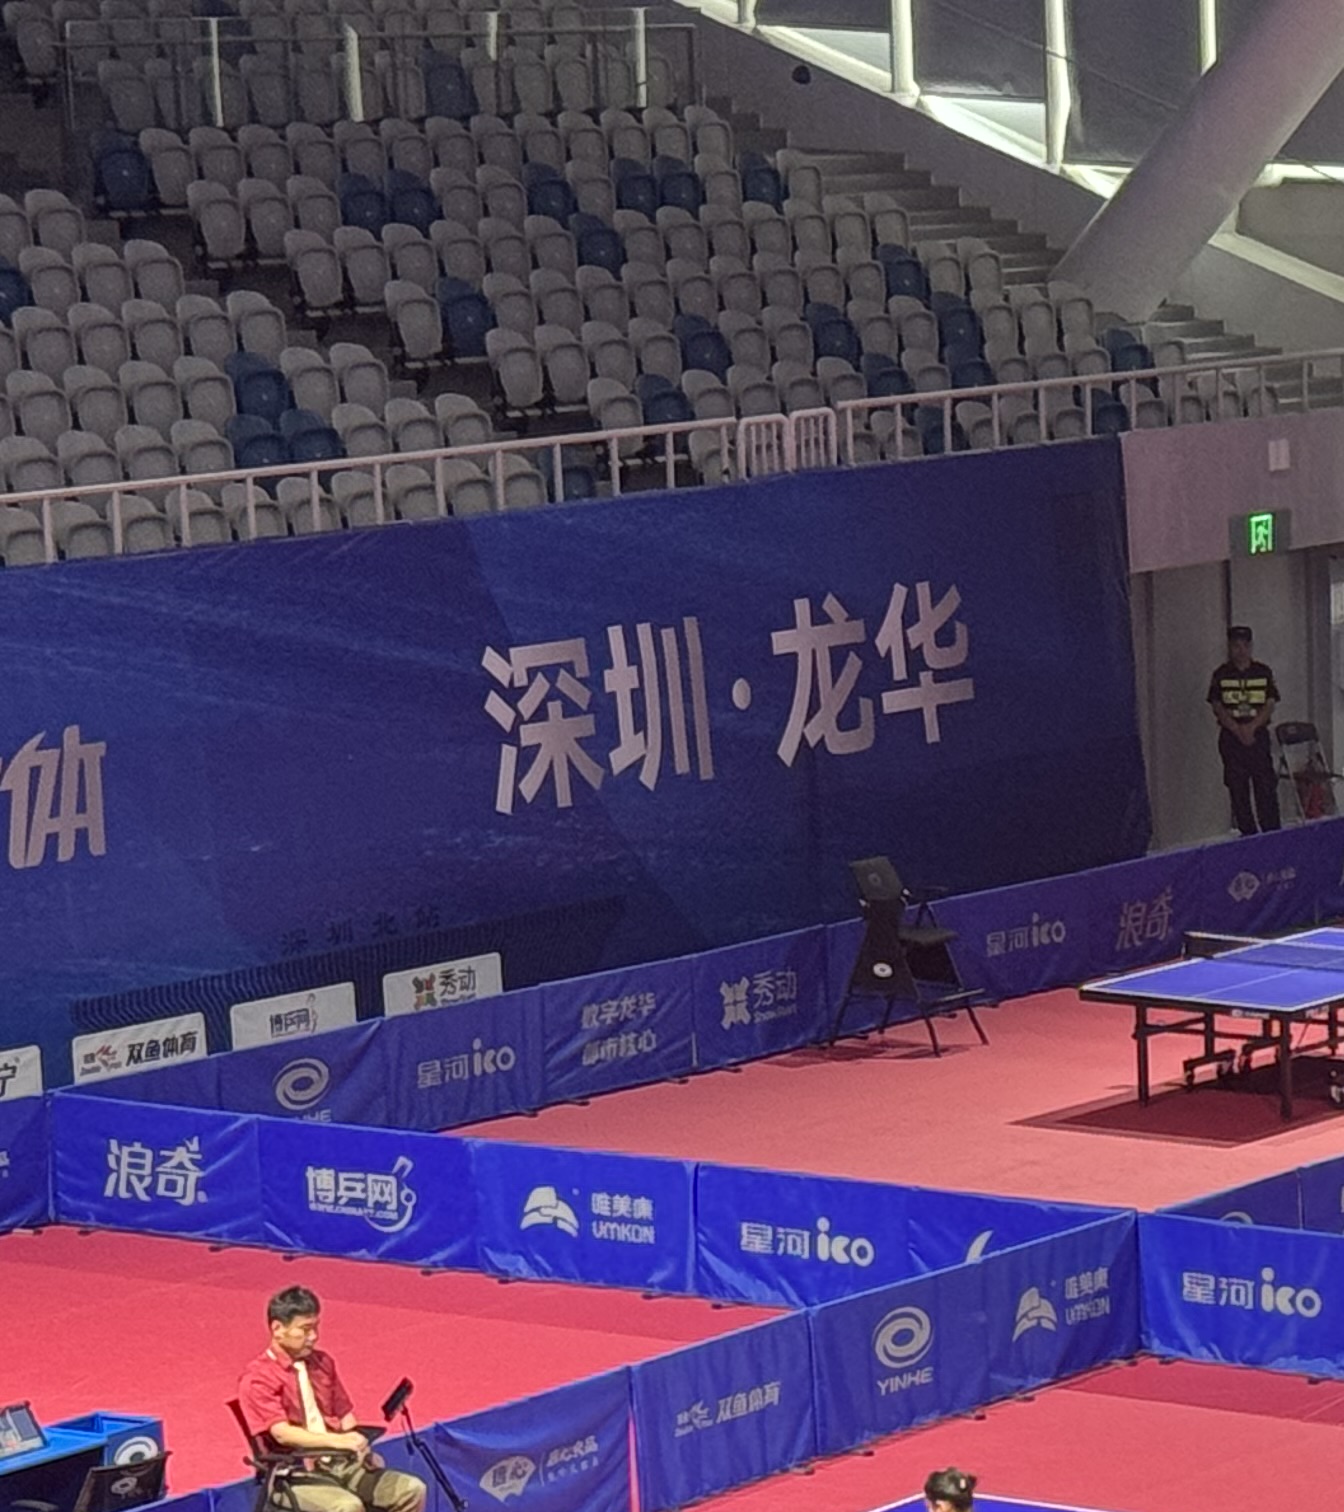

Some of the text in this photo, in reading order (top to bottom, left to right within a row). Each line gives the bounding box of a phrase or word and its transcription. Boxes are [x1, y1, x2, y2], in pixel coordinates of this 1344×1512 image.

[480, 581, 977, 816] 深圳·龙华
[103, 1138, 208, 1206] 浪奇
[305, 1165, 400, 1208] 博乒网
[590, 1192, 655, 1220] 唯美康
[739, 1216, 876, 1268] 星河ico
[1182, 1266, 1322, 1319] 星河ico
[877, 1366, 934, 1396] YINHE
